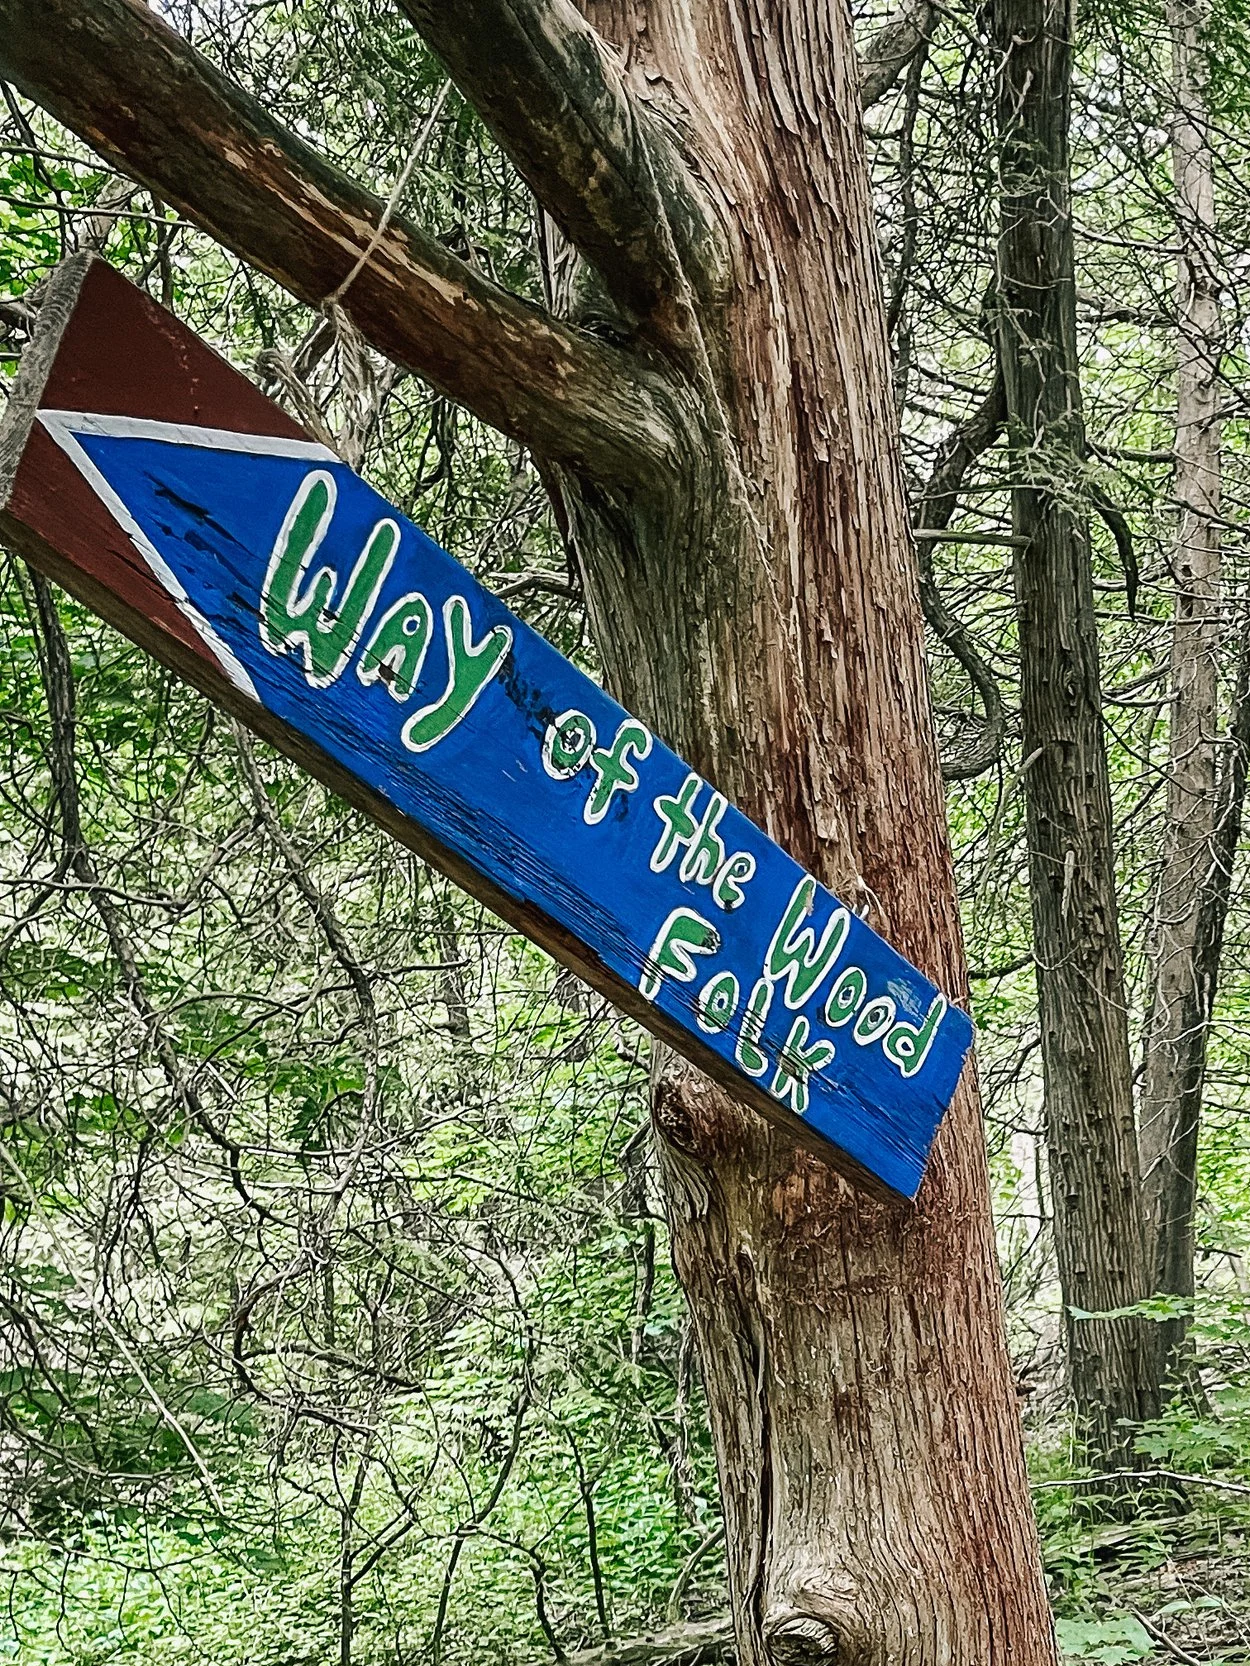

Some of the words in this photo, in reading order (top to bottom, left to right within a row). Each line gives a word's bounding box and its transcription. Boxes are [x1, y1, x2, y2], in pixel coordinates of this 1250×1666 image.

[542, 708, 652, 825] of
[650, 772, 756, 910] the
[763, 873, 947, 1078] Wood
